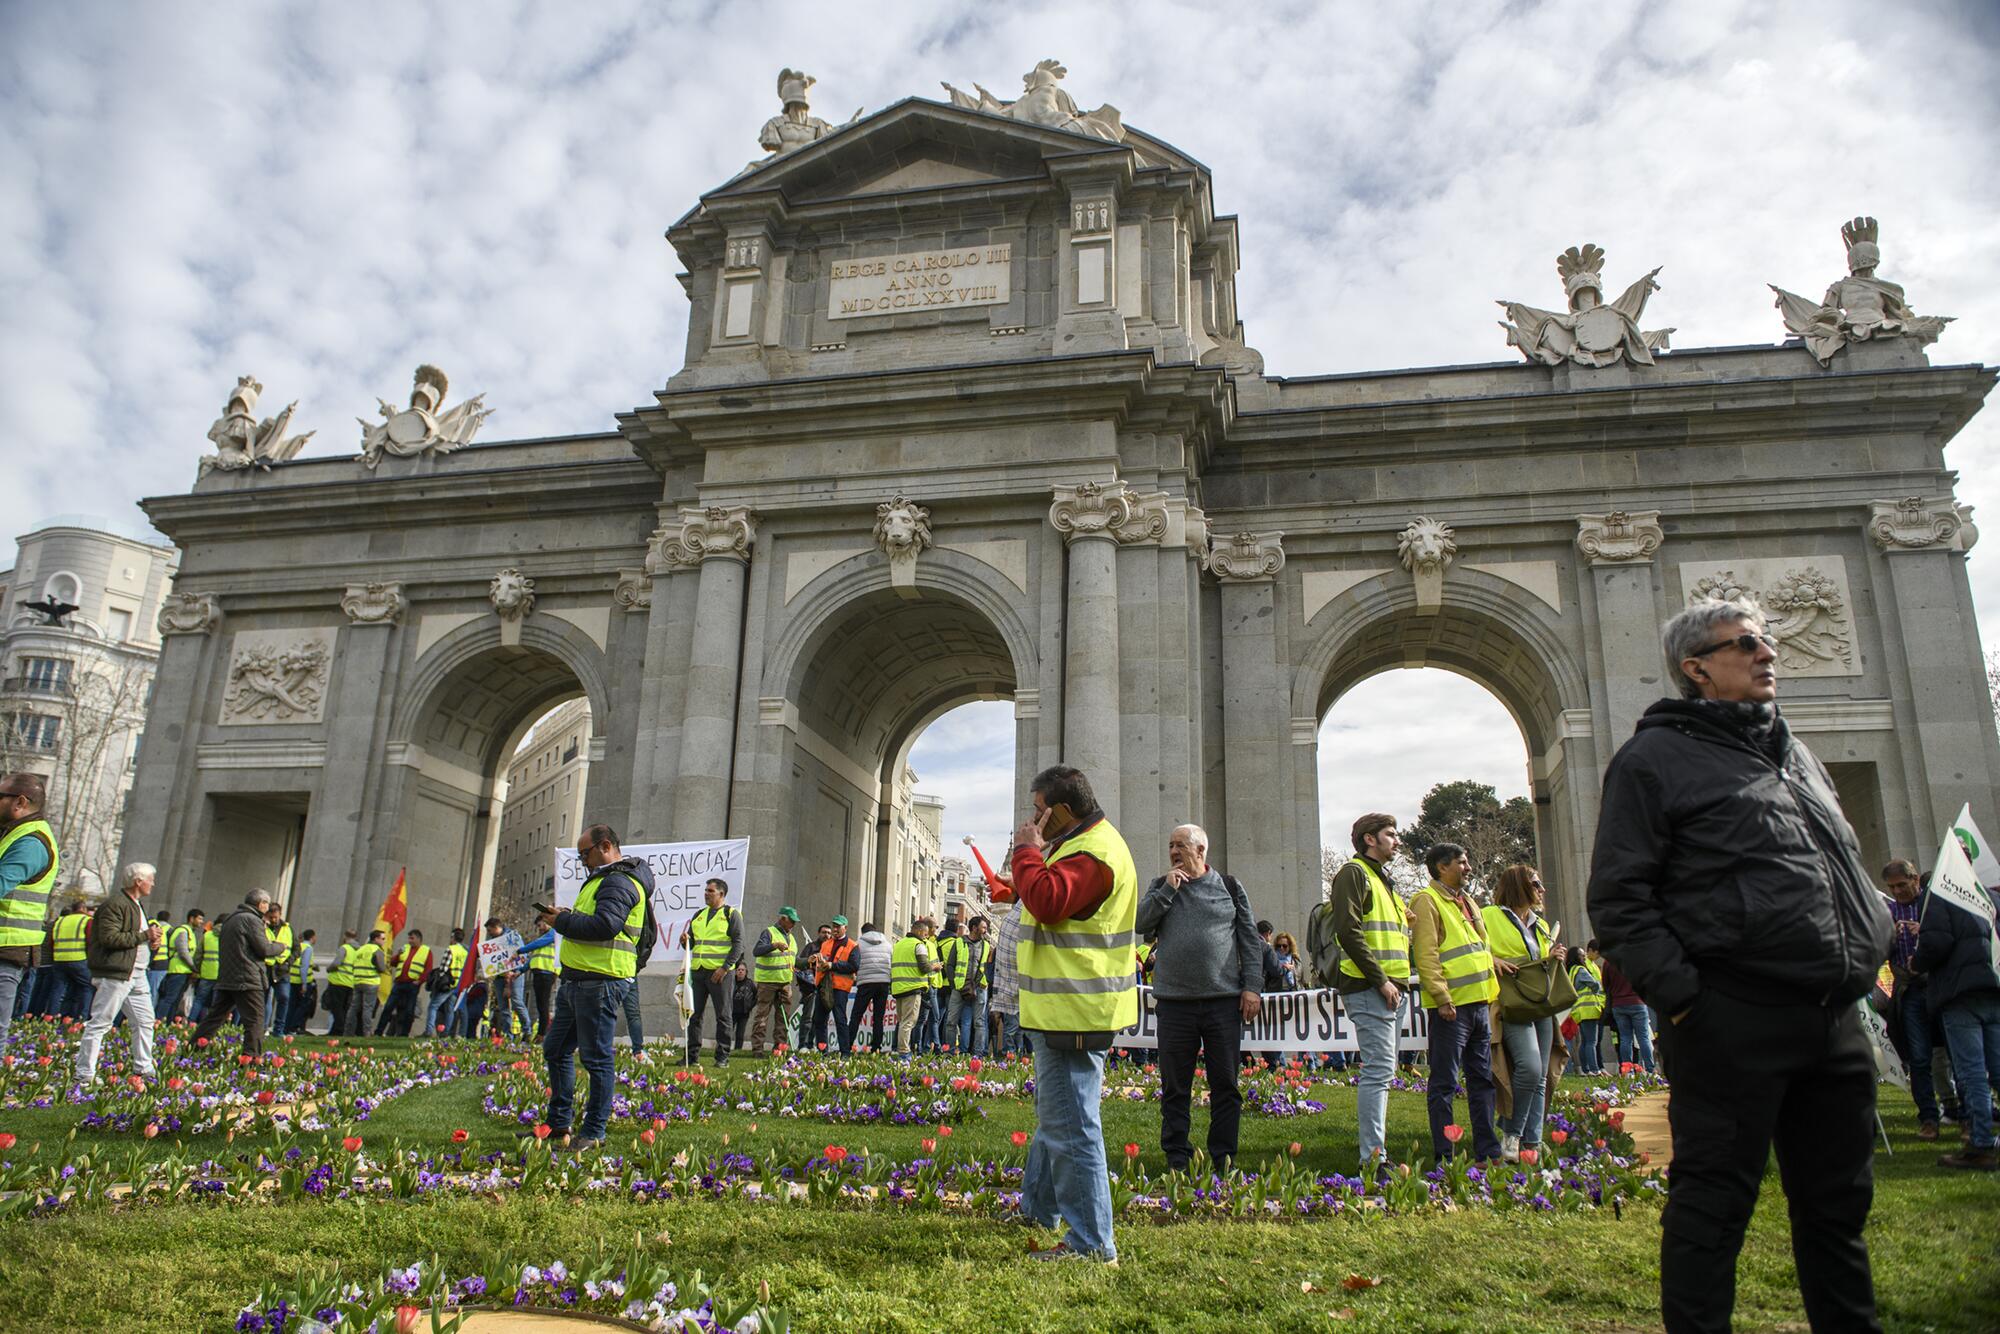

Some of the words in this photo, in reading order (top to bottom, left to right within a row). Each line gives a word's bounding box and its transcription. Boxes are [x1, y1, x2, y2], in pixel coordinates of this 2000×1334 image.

[831, 262, 886, 280] REGE
[892, 252, 980, 273] CAROLO
[986, 248, 1011, 264] III
[886, 272, 952, 292] ANNO
[841, 285, 997, 314] MDCCLXXVIII
[1240, 992, 1310, 1041] AMPO
